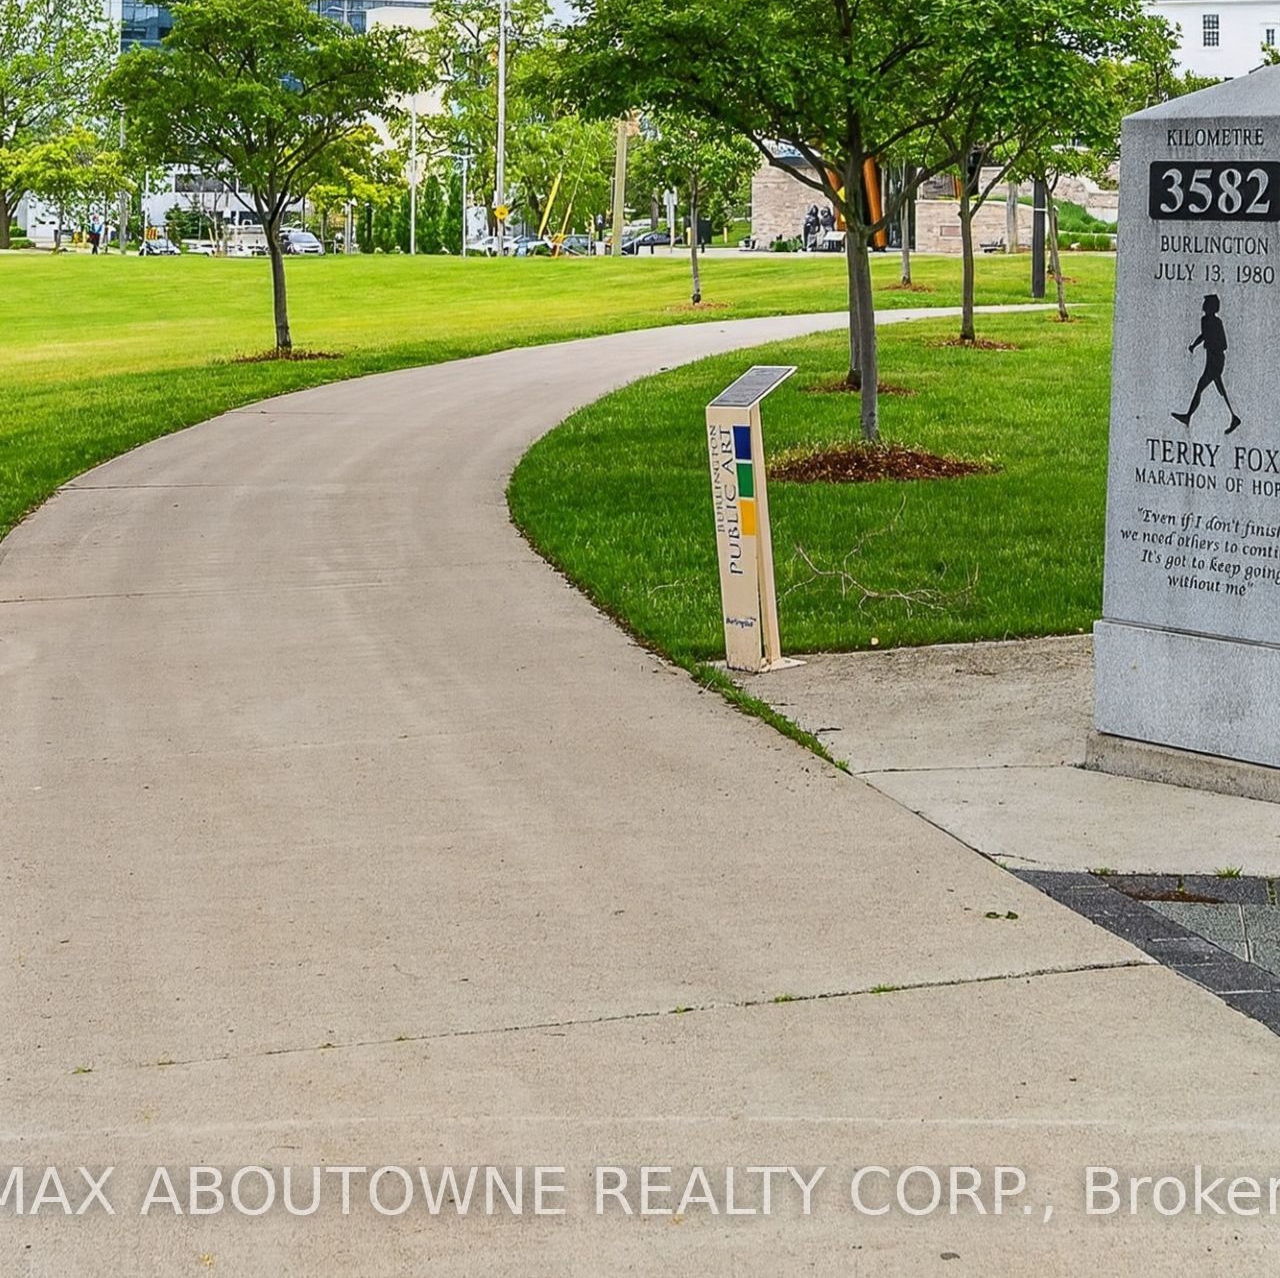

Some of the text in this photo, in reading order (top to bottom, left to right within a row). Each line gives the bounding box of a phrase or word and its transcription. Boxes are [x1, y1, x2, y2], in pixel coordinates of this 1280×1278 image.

[1167, 129, 1264, 146] KILOMETRE
[1160, 168, 1270, 213] 3582
[1161, 235, 1269, 254] BURLINGTON
[1155, 263, 1195, 281] JULY
[1236, 265, 1275, 284] 1980
[1146, 438, 1280, 474] TERRY FOX
[710, 425, 726, 533] BURLINGTON
[1135, 467, 1217, 490] MARATHON
[1225, 477, 1243, 493] OF
[720, 424, 744, 575] PUBLIC ART
[1137, 506, 1176, 525] "Even
[1181, 512, 1193, 532] if
[1194, 515, 1202, 529] I
[1205, 515, 1240, 533] don't
[1120, 528, 1138, 541] we
[1143, 530, 1175, 546] need
[1177, 533, 1220, 552] others
[1224, 540, 1238, 554] to
[1141, 549, 1162, 564] It's
[1165, 554, 1186, 569] got
[1192, 556, 1205, 570] to
[1210, 557, 1241, 578] keep
[1167, 574, 1220, 592] without
